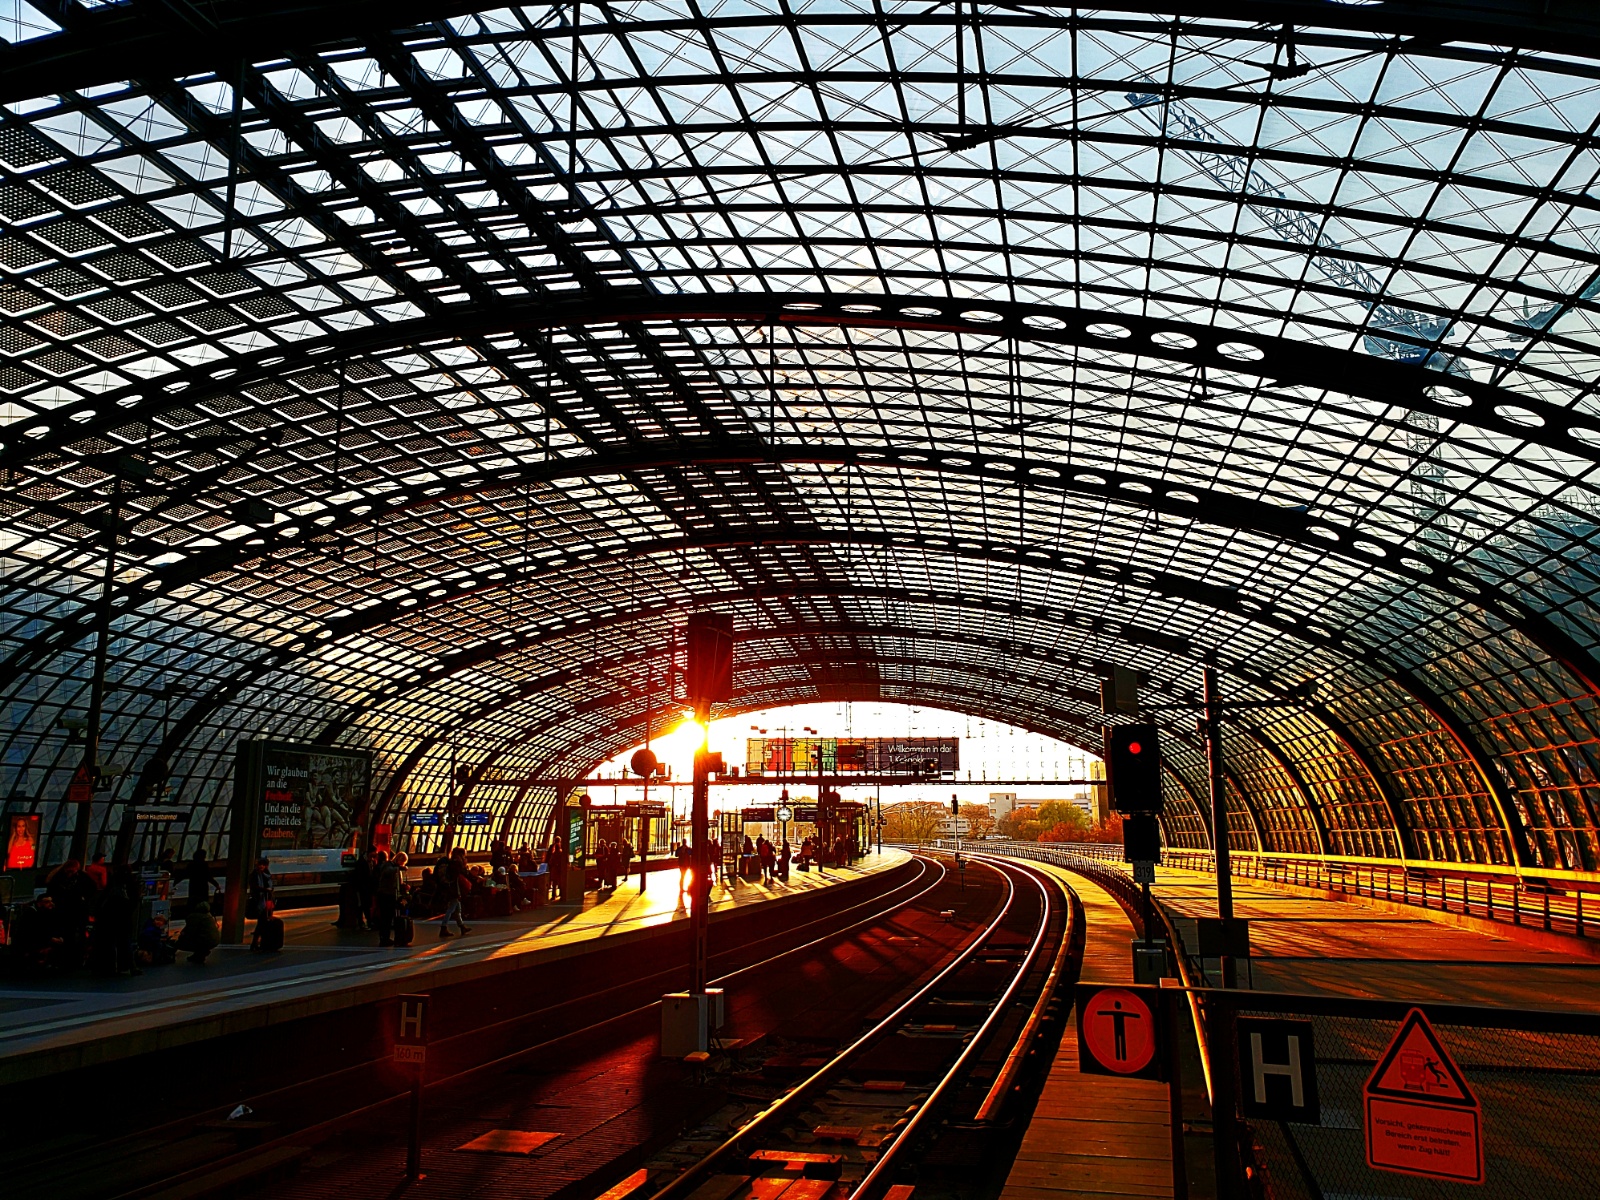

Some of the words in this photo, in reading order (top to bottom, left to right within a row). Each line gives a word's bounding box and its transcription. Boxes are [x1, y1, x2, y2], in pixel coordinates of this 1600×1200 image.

[888, 744, 930, 753] Willkommen
[932, 745, 939, 753] in
[266, 765, 280, 776] Wir
[281, 766, 308, 778] glauben
[266, 780, 276, 788] an
[276, 778, 288, 788] die
[264, 802, 280, 813] Und
[289, 803, 301, 814] die
[149, 813, 178, 821] Hauptbahnhof
[263, 815, 290, 826] Freiheit
[290, 816, 302, 826] des
[263, 828, 296, 838] Glaubens.
[1136, 867, 1151, 878] 319
[399, 1001, 423, 1038] H
[1250, 1032, 1304, 1107] H
[1385, 1130, 1412, 1139] Bereich
[1407, 1123, 1471, 1138] gekennzeichneten
[1397, 1143, 1417, 1151] wenn
[1418, 1145, 1432, 1155] Zug
[1434, 1147, 1450, 1156] hält!
